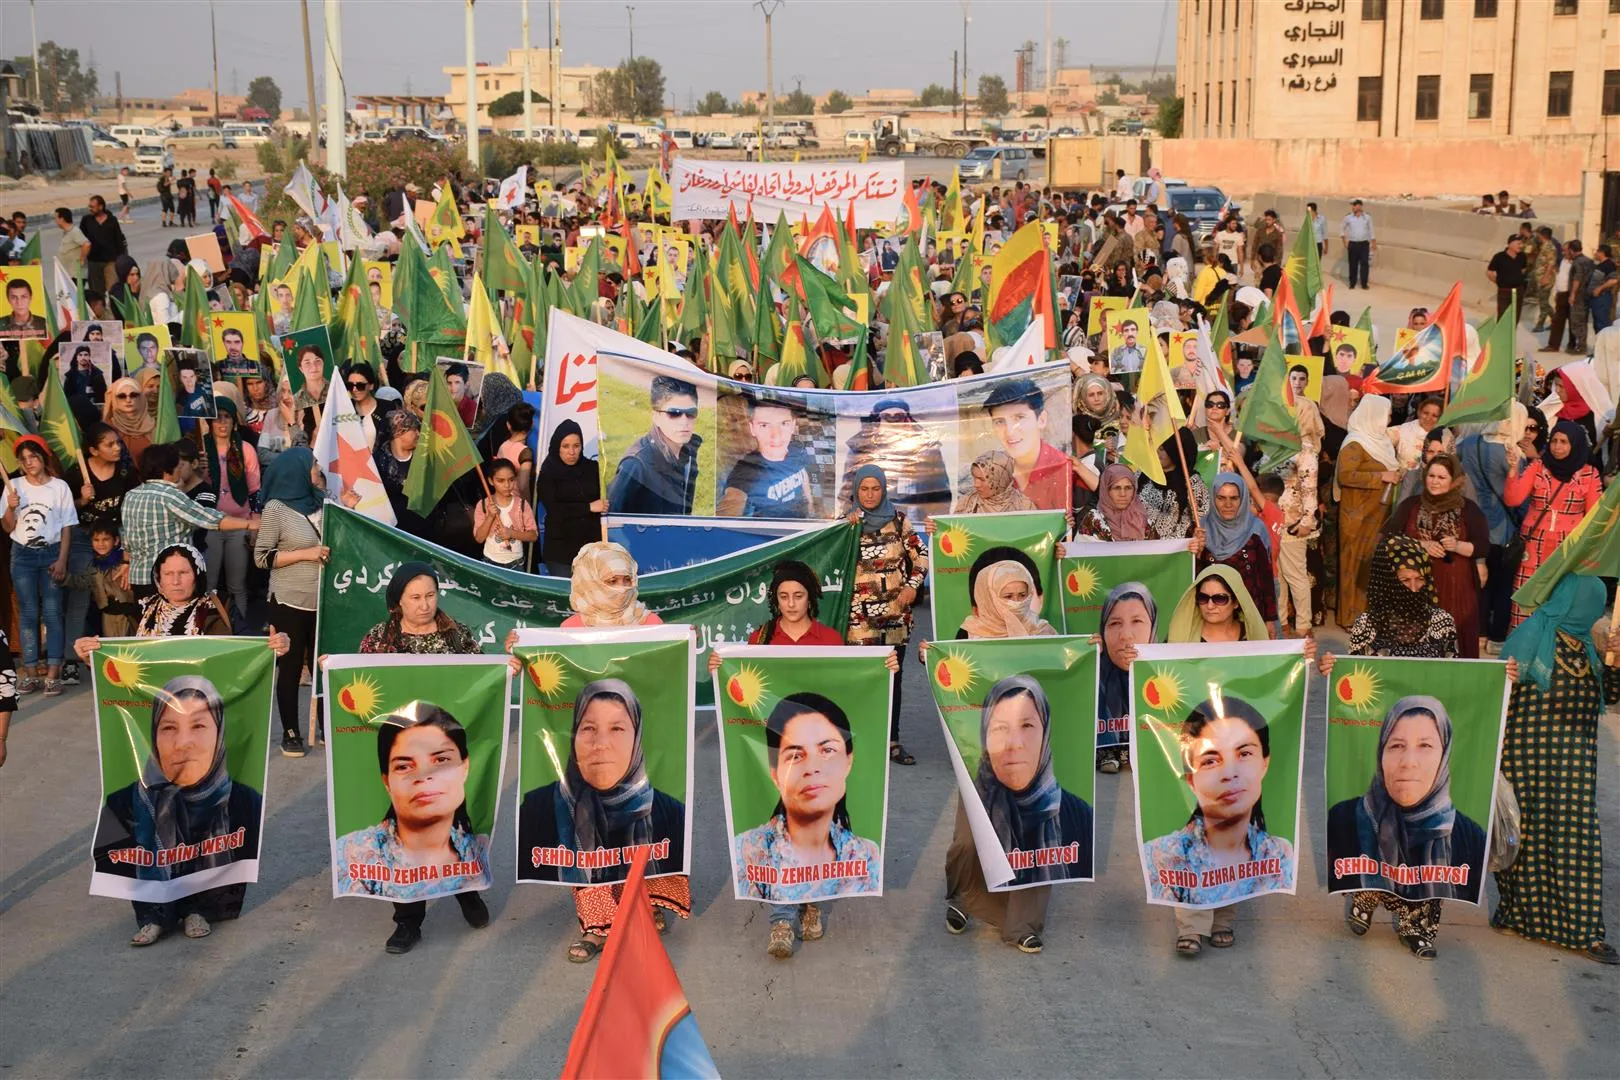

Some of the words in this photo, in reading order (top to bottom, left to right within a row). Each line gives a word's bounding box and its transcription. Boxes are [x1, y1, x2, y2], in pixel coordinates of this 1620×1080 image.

[1284, 20, 1344, 42] التجاري
[1282, 48, 1343, 68] السوري
[1288, 73, 1311, 92] رقم
[1314, 72, 1337, 92] فرع
[1107, 713, 1130, 733] EMÎ
[156, 843, 200, 868] EMÎNE
[200, 826, 247, 857] WEYSÎ
[532, 844, 575, 868] ŞEHÎD
[576, 845, 621, 869] EMÎNE
[622, 838, 671, 864] WYSÎ
[1006, 848, 1035, 870] MÎNE
[1036, 841, 1080, 868] WEYSÎ
[349, 861, 392, 882] ŞEHÎD
[393, 864, 440, 885] ZEHRA
[442, 860, 484, 878] BERK
[747, 863, 778, 884] ŞEHÎD
[781, 864, 820, 885] ZEHRA
[822, 860, 869, 880] BERKEL
[1159, 867, 1198, 889] ŞEHÎD
[1201, 864, 1236, 888] ZEHRA
[1238, 858, 1281, 881] BERKEL
[1334, 853, 1379, 879] ŞEHÎD
[1380, 861, 1421, 886] EMÎNE
[1421, 863, 1470, 886] WEYSÎ
